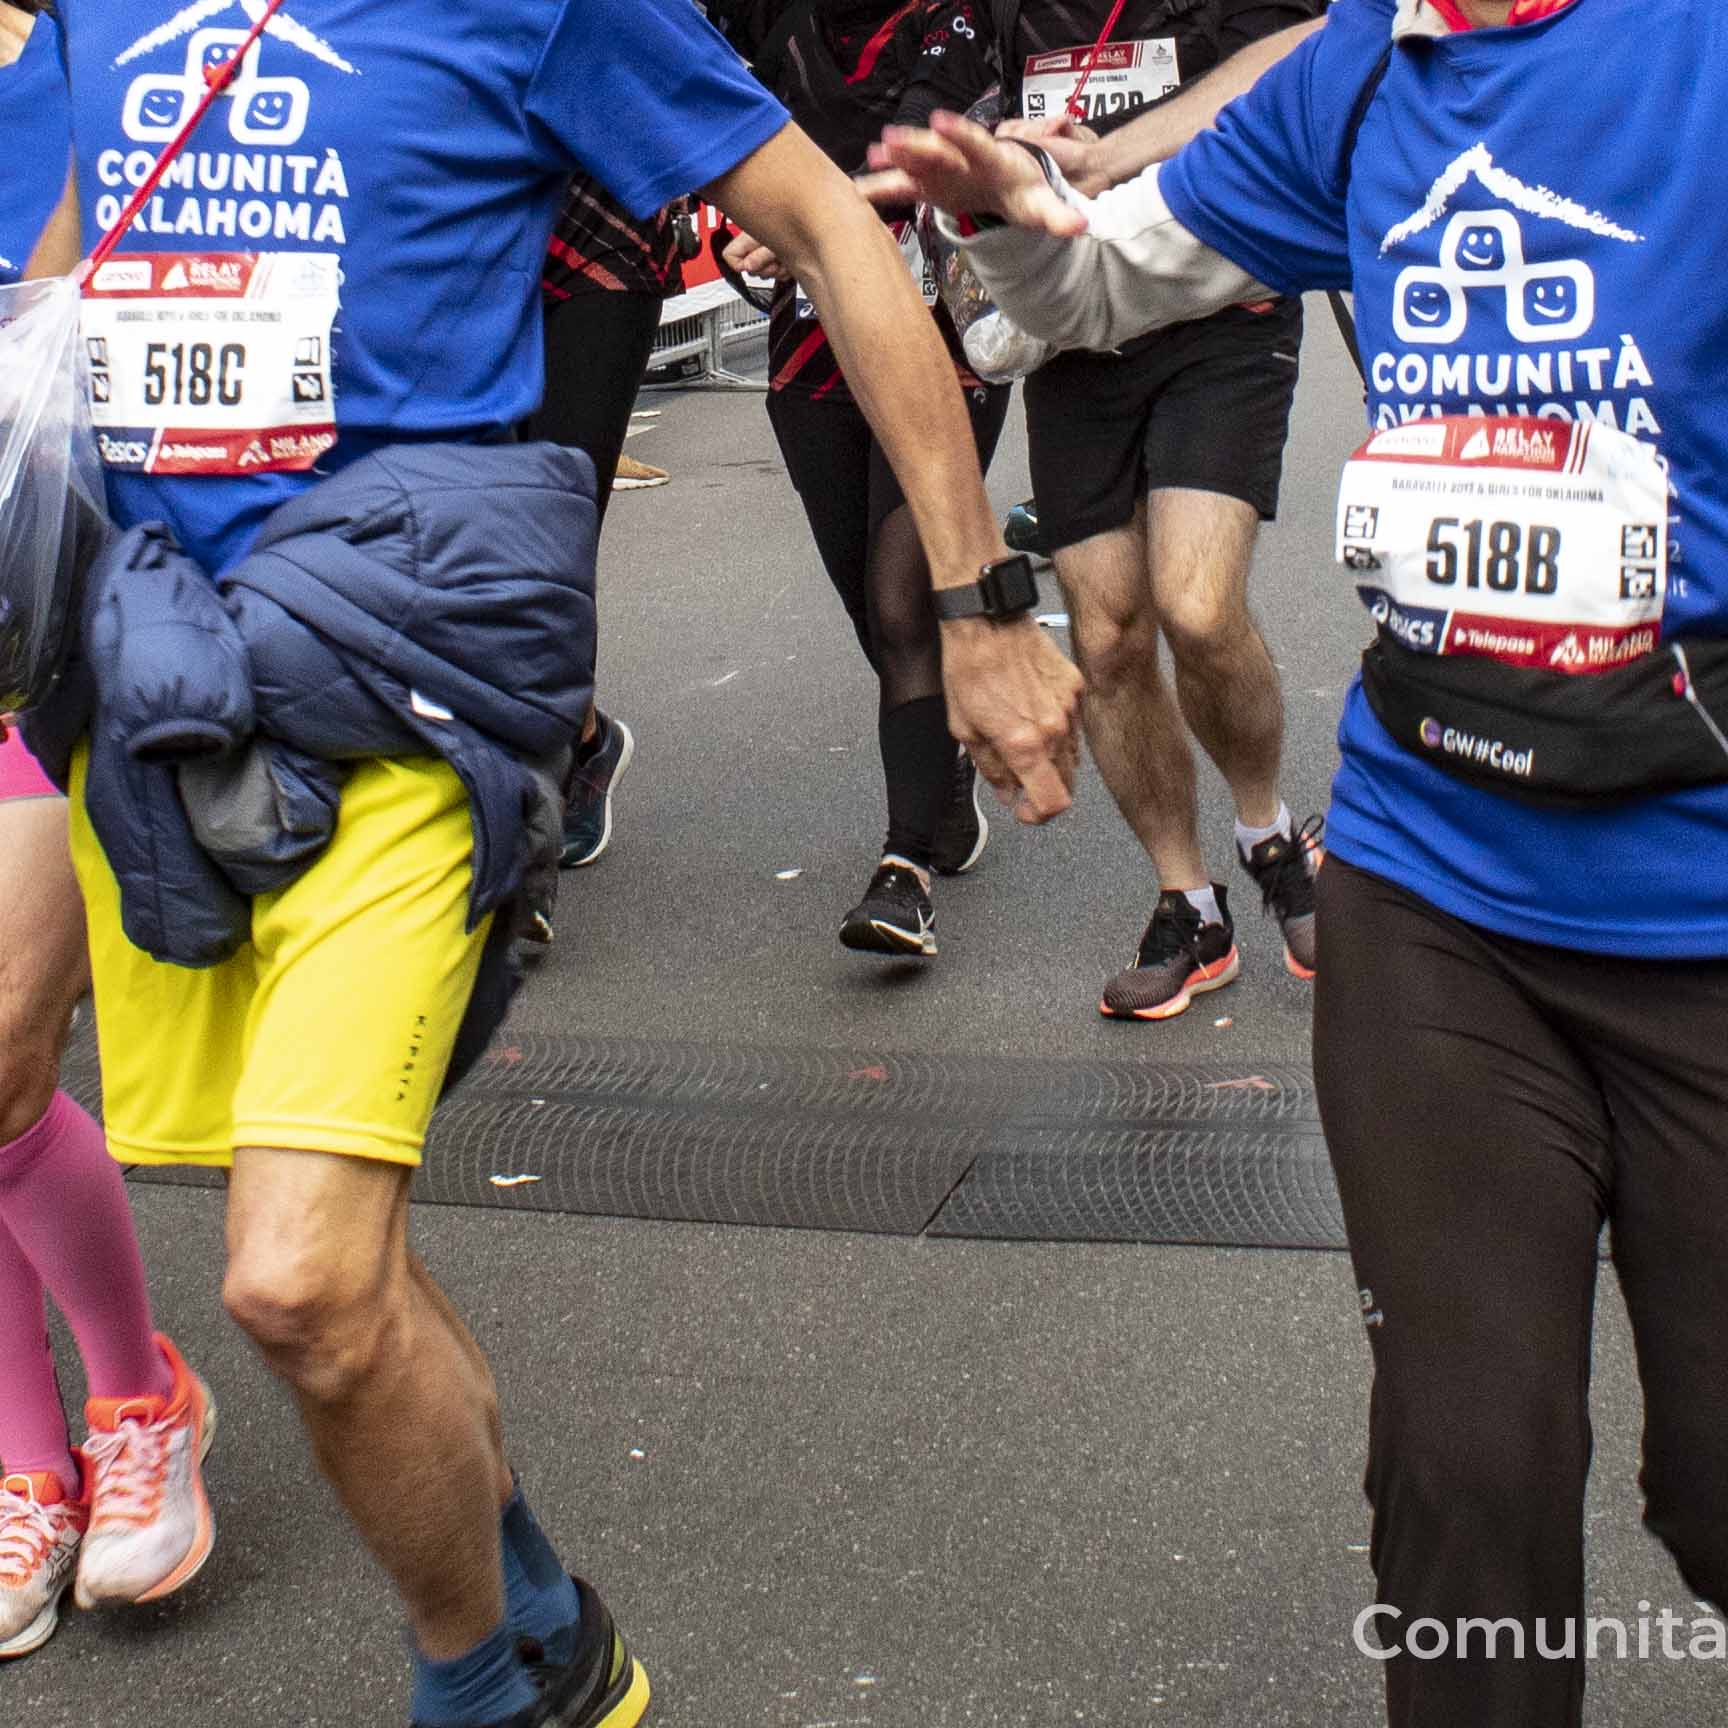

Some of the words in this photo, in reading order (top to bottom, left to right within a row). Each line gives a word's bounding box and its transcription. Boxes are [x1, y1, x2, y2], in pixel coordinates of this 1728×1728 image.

[96, 147, 350, 199] COMUNITÀ
[144, 342, 247, 406] 518C
[1372, 335, 1655, 398] COMUNITÀ
[1426, 517, 1564, 595] 518B
[1467, 629, 1535, 654] Telepass
[396, 1014, 427, 1101] KIPSTA
